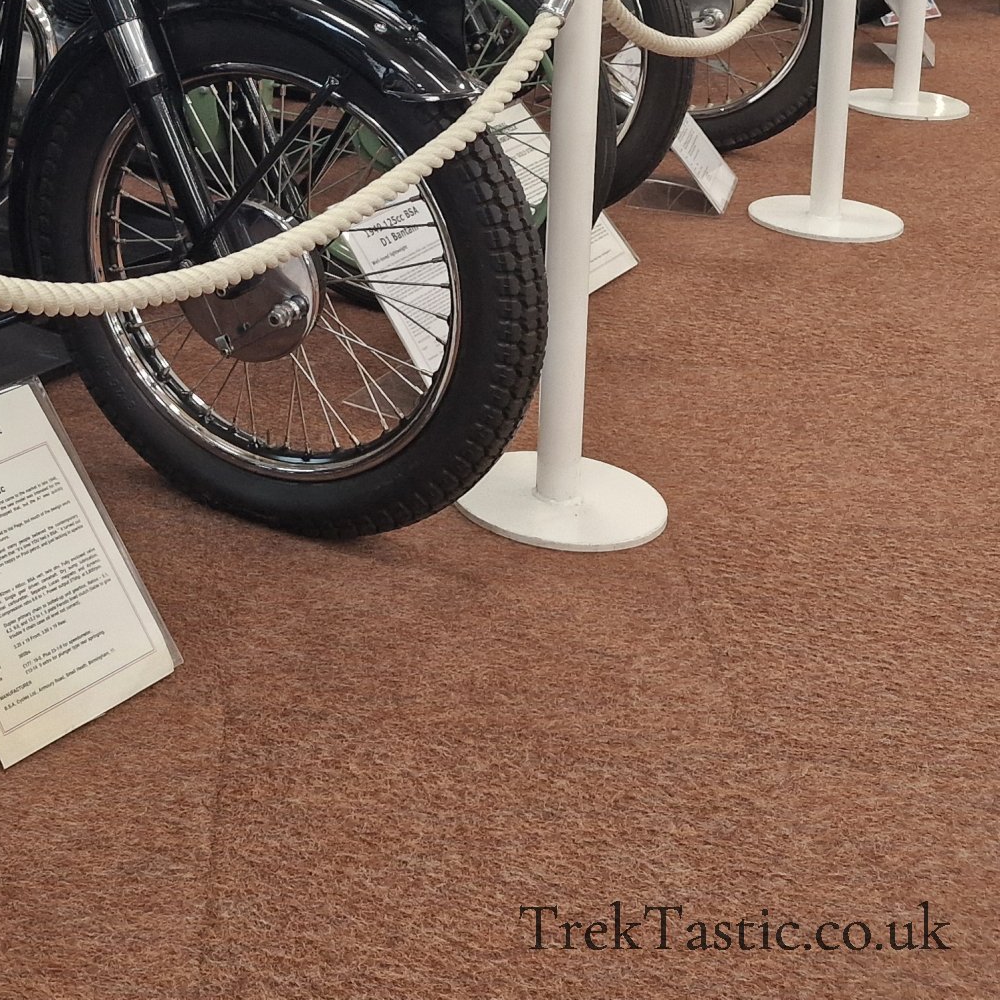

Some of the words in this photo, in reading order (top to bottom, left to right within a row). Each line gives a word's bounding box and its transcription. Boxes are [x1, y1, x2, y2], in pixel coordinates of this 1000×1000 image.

[383, 215, 404, 227] 125cc
[403, 206, 419, 219] BSA
[380, 237, 392, 247] D1
